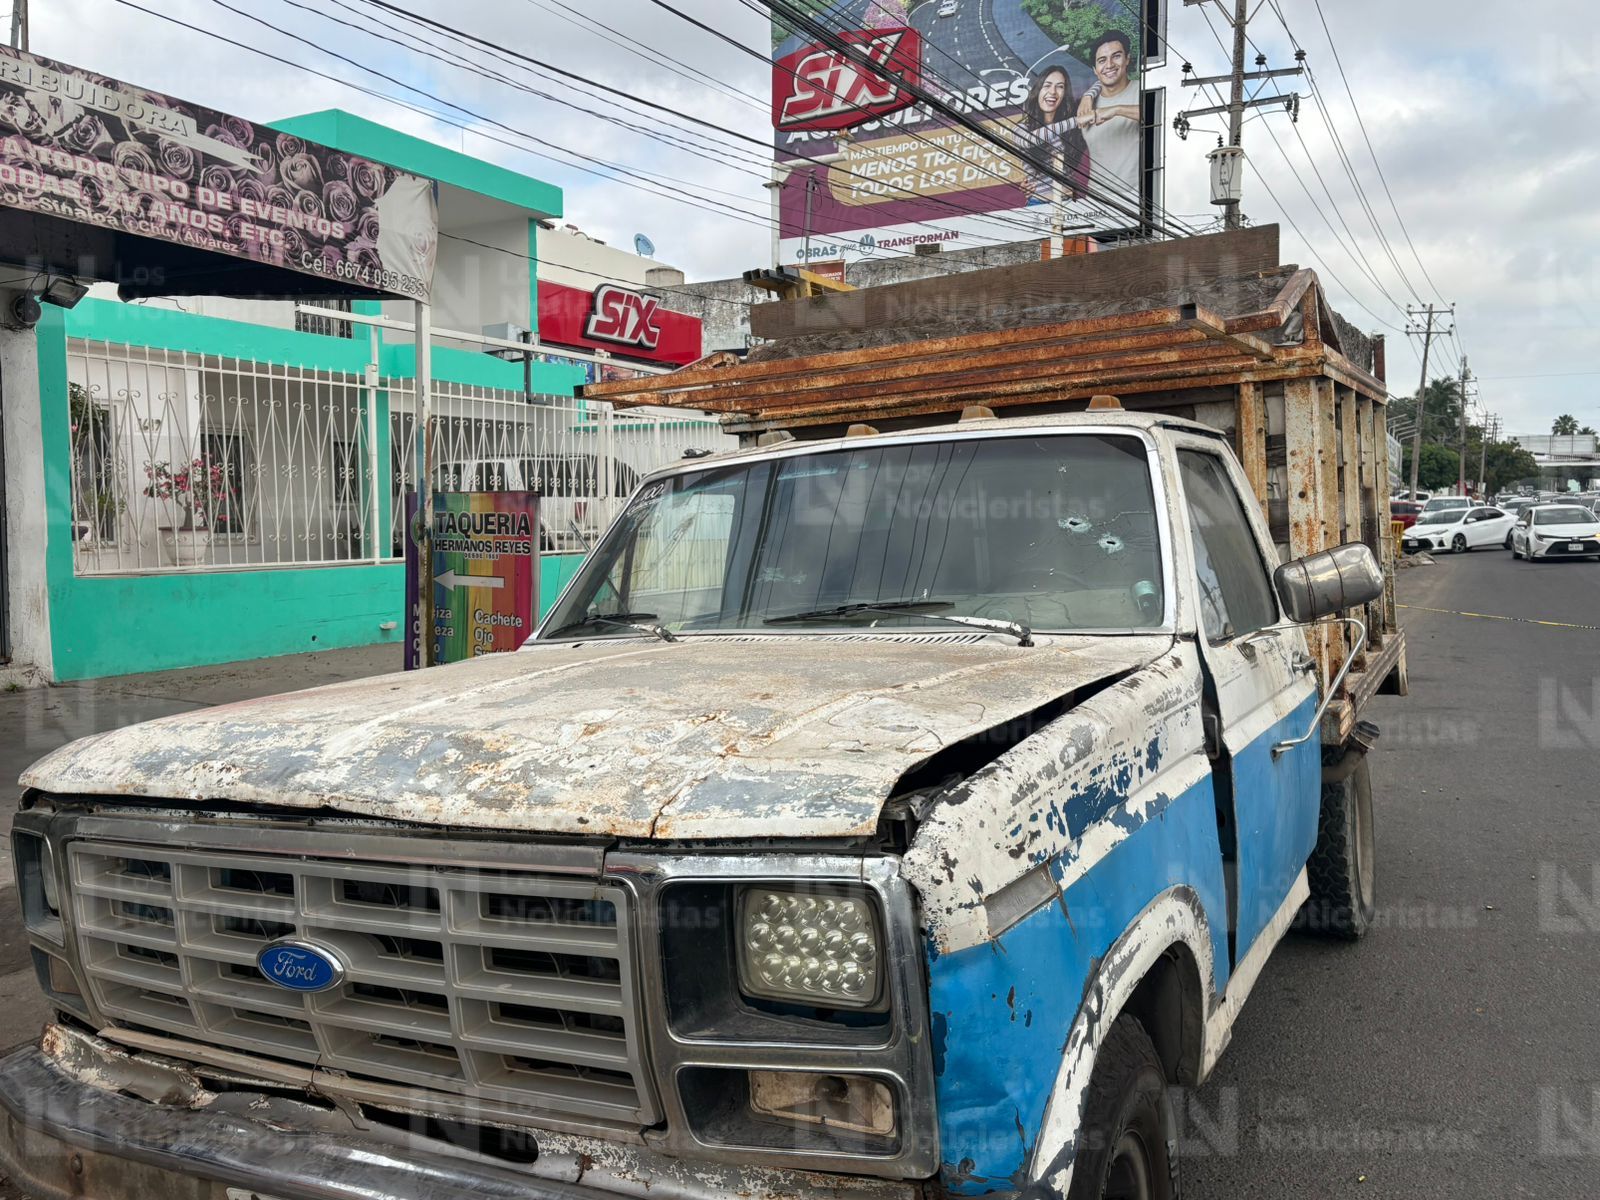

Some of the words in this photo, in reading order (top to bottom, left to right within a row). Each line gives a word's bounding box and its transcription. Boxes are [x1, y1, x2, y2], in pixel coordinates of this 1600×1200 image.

[876, 141, 919, 156] TIEMPO
[920, 136, 945, 149] CON
[946, 133, 962, 145] TU
[849, 155, 918, 180] MENOS
[923, 143, 1008, 168] TRÁFICO
[850, 174, 915, 199] TODOS
[919, 168, 959, 189] LOS
[963, 157, 1013, 183] DÍAS
[121, 167, 190, 199] TIPO
[198, 187, 234, 211] DE
[240, 198, 346, 240] EVENTOS
[139, 220, 180, 241] Chuy
[184, 228, 240, 252] Álvarez
[796, 245, 837, 260] OBRAS
[877, 231, 960, 248] TRANSFORMAN
[301, 250, 331, 274] Cel.
[335, 260, 369, 283] 6674
[373, 268, 398, 289] 095
[401, 274, 425, 297] 255
[434, 511, 531, 538] TAQUERIA
[434, 539, 492, 553] HERMANOS
[495, 540, 531, 555] REYES
[474, 609, 522, 627] Cachete
[474, 627, 494, 645] Ojo
[273, 950, 317, 981] Ford
